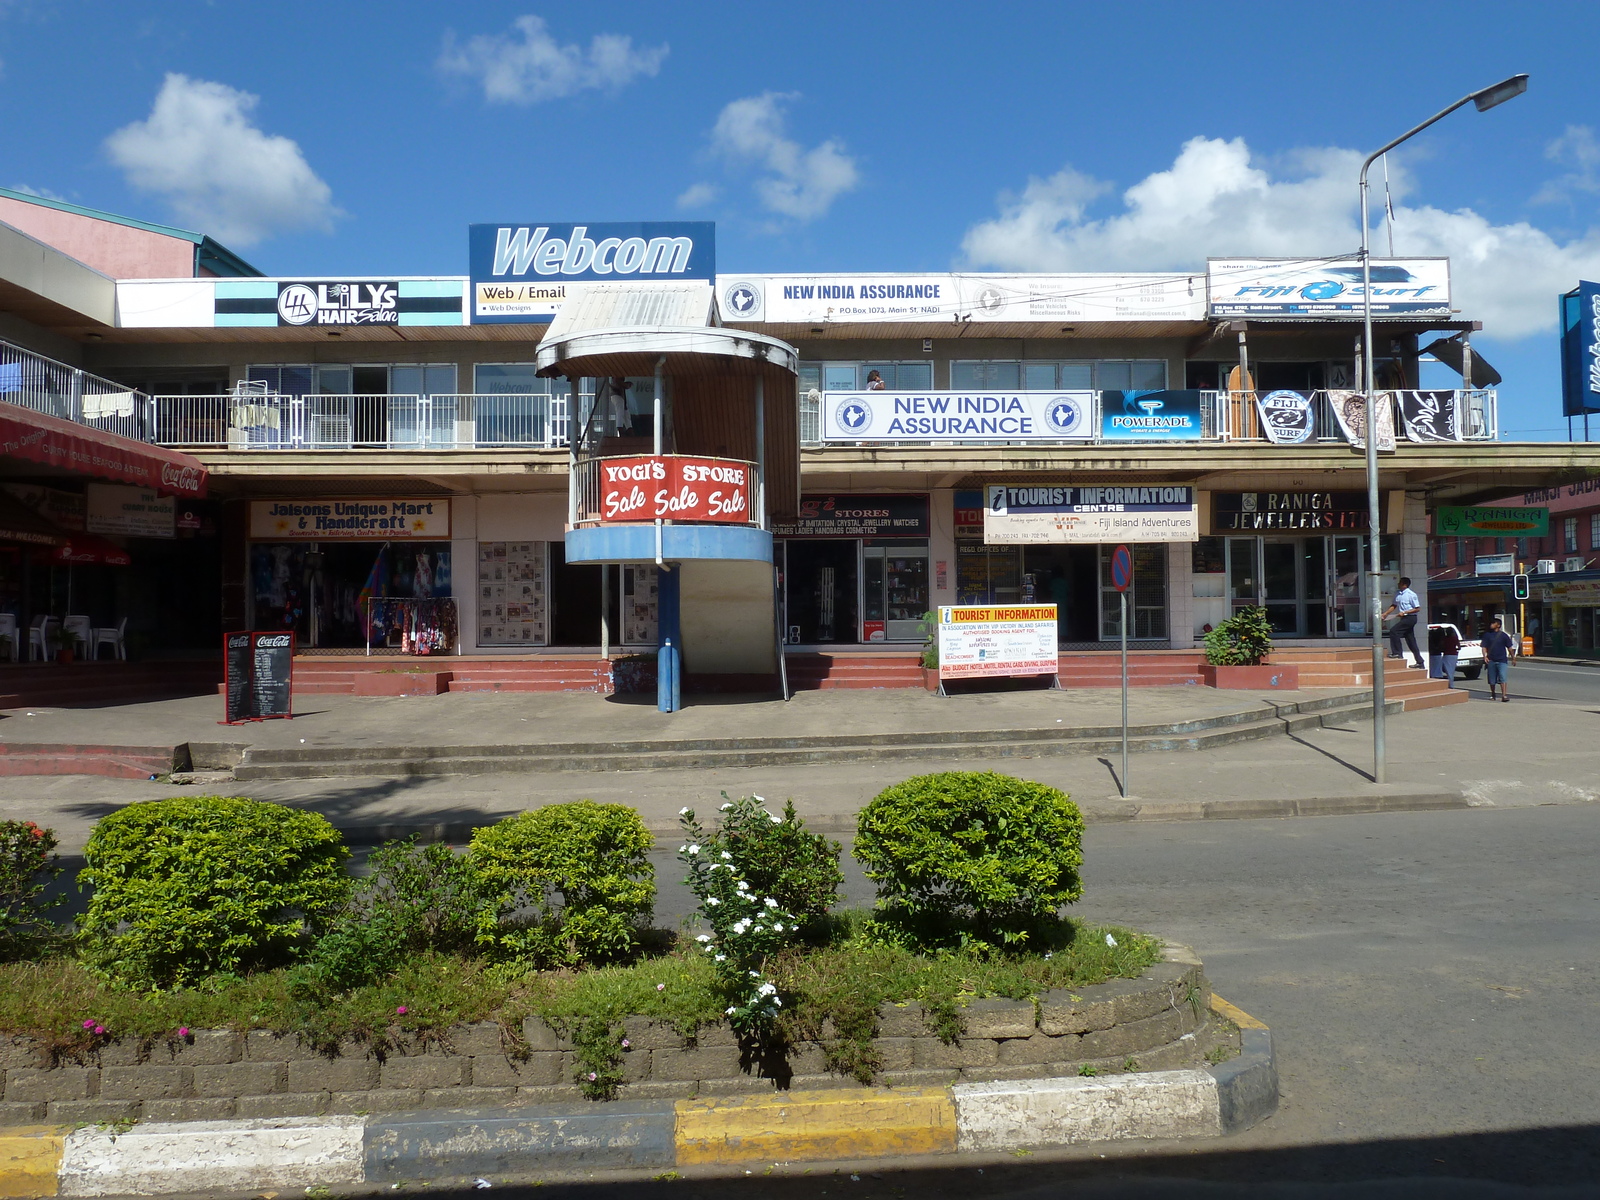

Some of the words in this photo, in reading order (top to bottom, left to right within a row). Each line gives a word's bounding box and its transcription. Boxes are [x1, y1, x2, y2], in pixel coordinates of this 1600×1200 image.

[492, 226, 693, 276] Webcom
[482, 286, 514, 300] Web
[528, 286, 566, 298] Email
[784, 286, 814, 300] NEW
[818, 286, 855, 299] INDIA
[860, 284, 940, 298] ASSURANCE
[1234, 286, 1298, 298] Fiji
[1347, 286, 1438, 297] Surf
[318, 310, 358, 324] HAIR
[354, 304, 398, 326] Salon
[488, 381, 532, 394] Webcom
[894, 397, 950, 414] NEW
[958, 397, 1024, 414] INDIA
[1272, 400, 1298, 408] FIJI
[887, 417, 1032, 434] ASSURANCE
[1273, 428, 1300, 438] SURF
[606, 460, 666, 482] YOGI'S
[682, 464, 744, 486] STORE
[606, 485, 646, 518] Sale
[654, 485, 698, 516] Sale
[708, 488, 746, 516] Sale
[1008, 488, 1074, 504] TOURIST
[1080, 487, 1187, 504] INFORMATION
[1268, 493, 1332, 510] RANIGA
[1524, 487, 1560, 506] MANJI
[269, 503, 332, 516] Jaisons
[334, 503, 388, 518] Unique
[392, 502, 434, 515] Mart
[835, 510, 890, 518] STORES
[1074, 504, 1125, 512] CENTRE
[298, 518, 308, 529] &
[316, 516, 406, 530] Handicraft
[1099, 518, 1110, 532] Fiji
[1112, 518, 1138, 528] Island
[1142, 517, 1192, 528] Adventures
[1230, 512, 1334, 529] JEWELLERS
[954, 610, 990, 621] TOURIST
[994, 608, 1055, 620] INFORMATION
